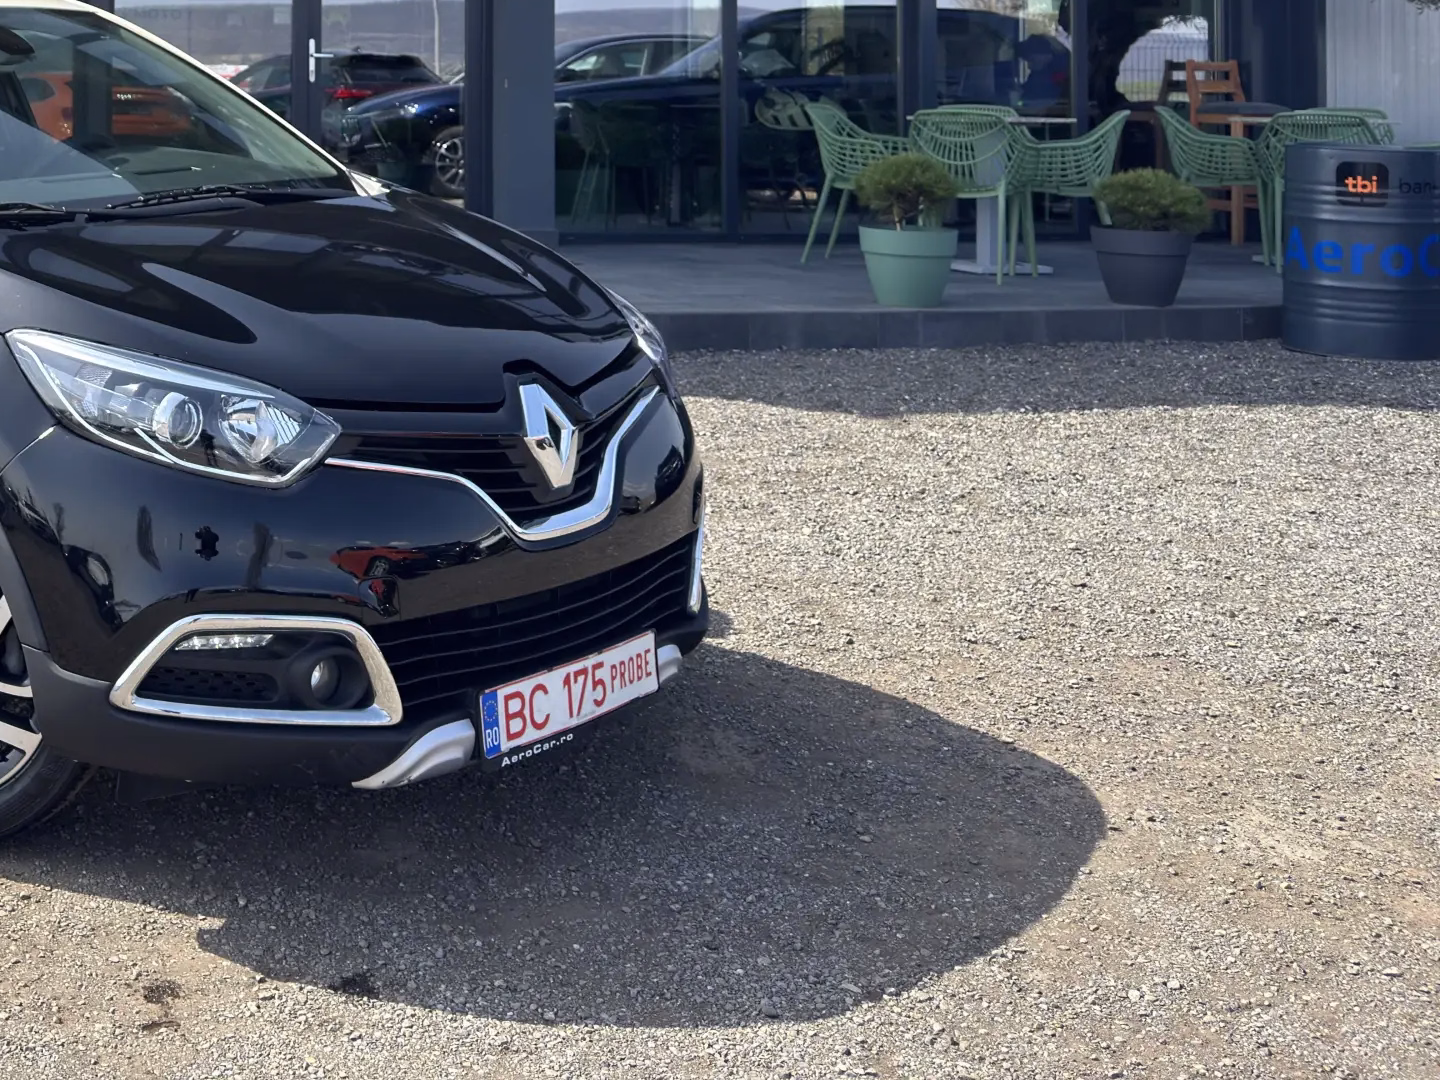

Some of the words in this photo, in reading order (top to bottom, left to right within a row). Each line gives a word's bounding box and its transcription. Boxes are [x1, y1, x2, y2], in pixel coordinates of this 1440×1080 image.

[1344, 175, 1378, 194] tbi
[1398, 176, 1439, 194] ban
[503, 683, 551, 743] BC
[563, 661, 607, 719] 175
[610, 648, 653, 694] PROBE
[485, 727, 500, 749] RO
[501, 732, 574, 767] AeroCar.ro
